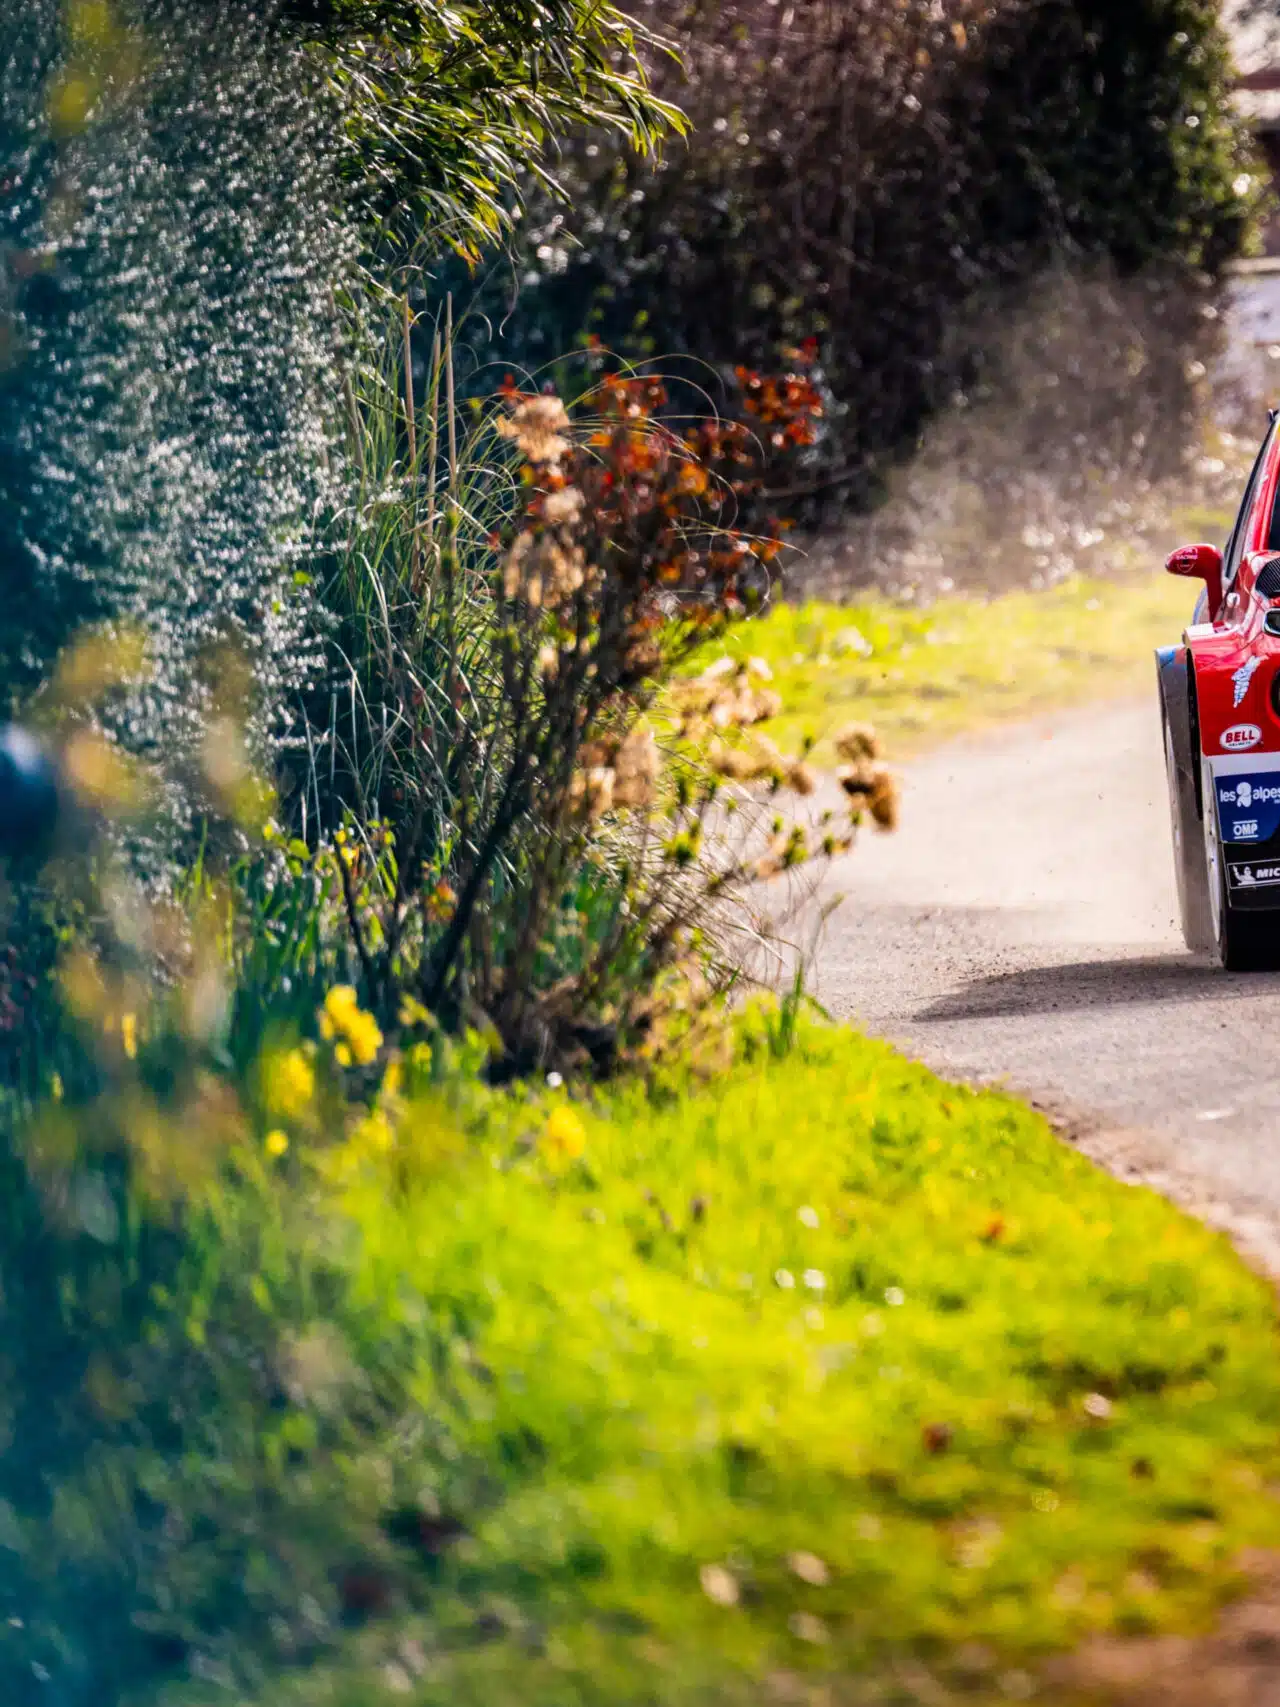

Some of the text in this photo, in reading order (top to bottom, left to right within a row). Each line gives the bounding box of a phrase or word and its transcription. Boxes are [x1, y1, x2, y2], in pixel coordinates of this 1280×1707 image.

[1225, 730, 1256, 743] BELL
[1220, 788, 1236, 802] les
[1233, 823, 1258, 836] OMP
